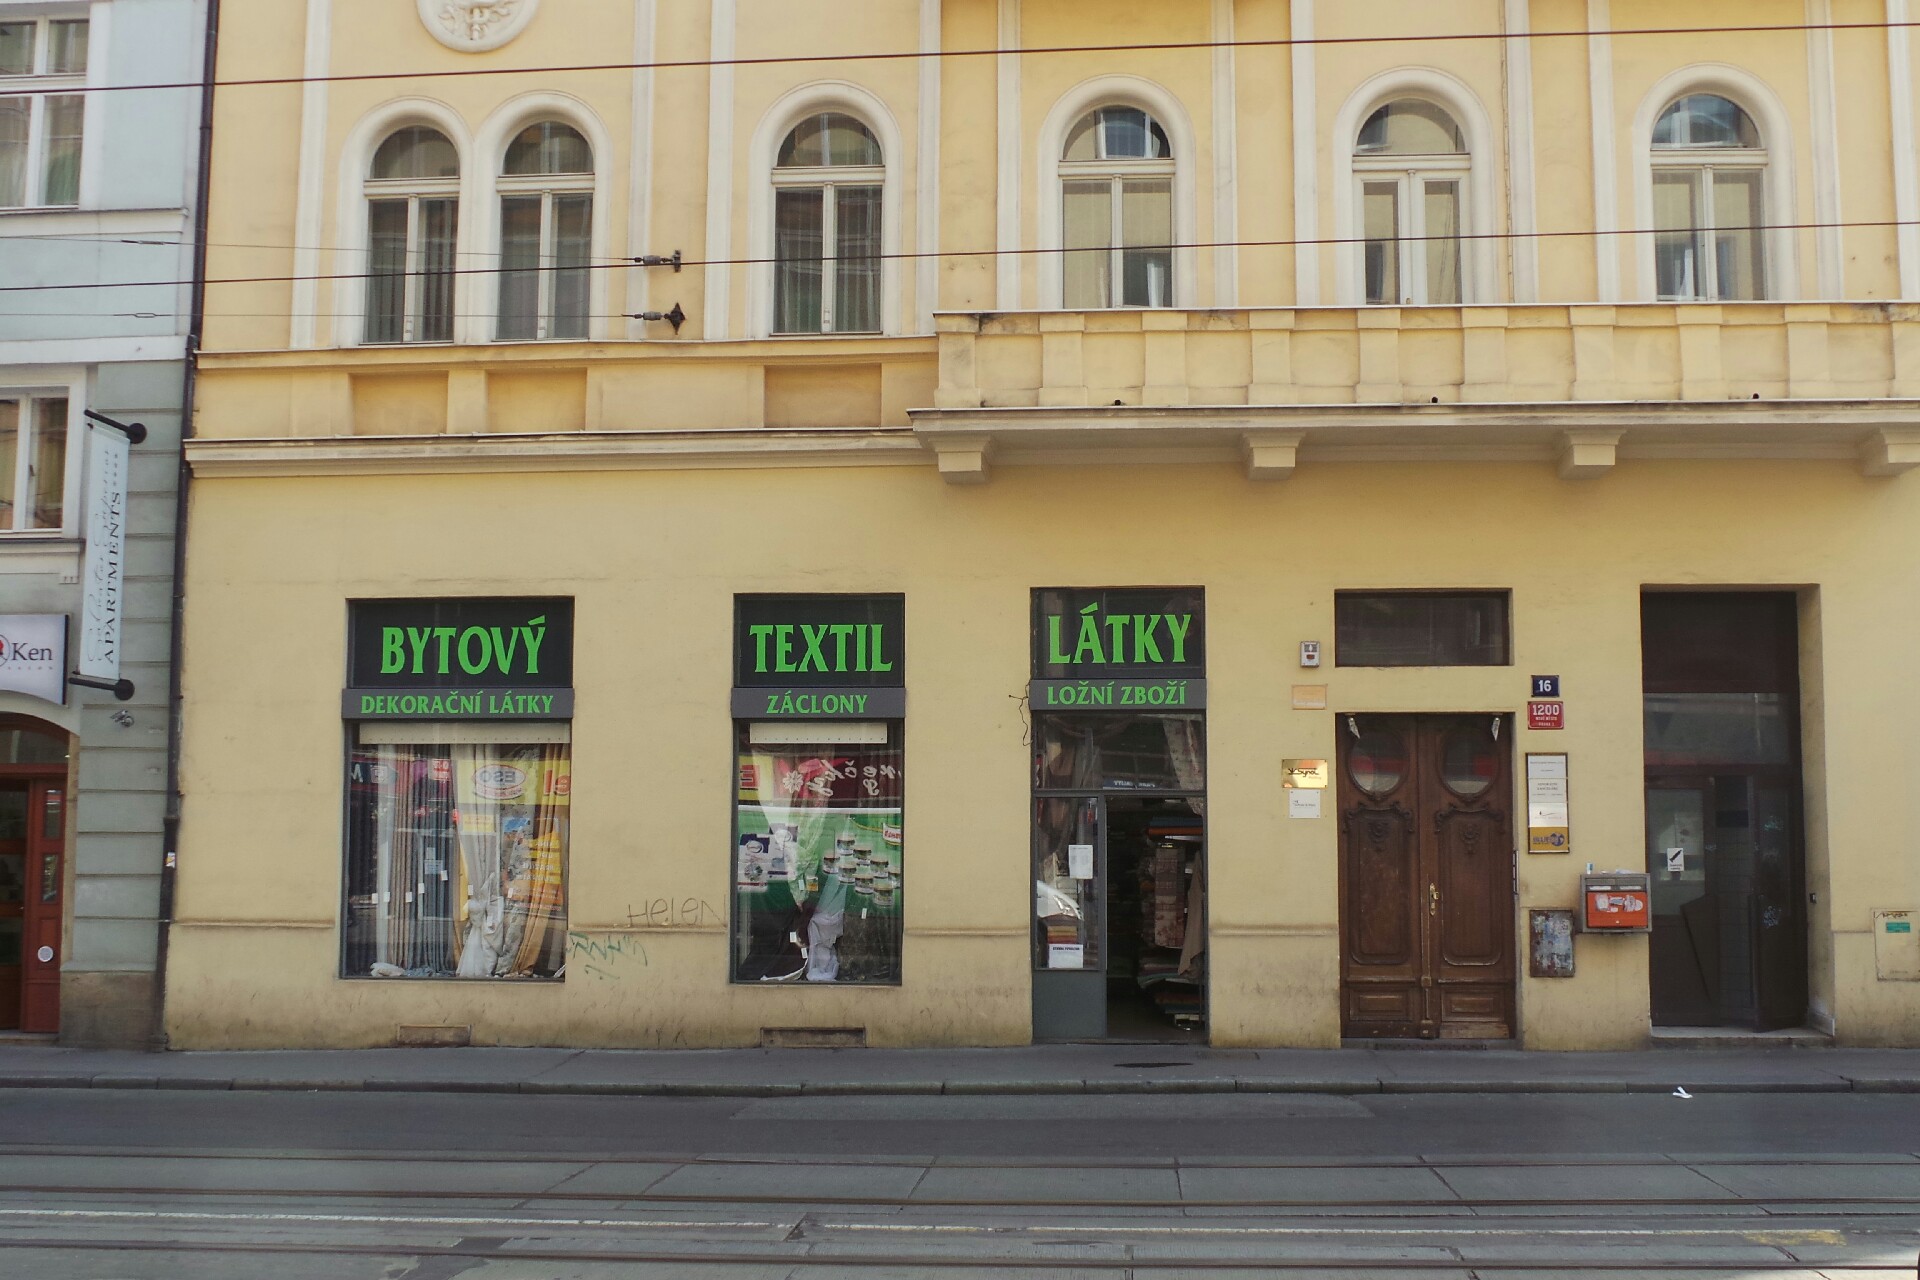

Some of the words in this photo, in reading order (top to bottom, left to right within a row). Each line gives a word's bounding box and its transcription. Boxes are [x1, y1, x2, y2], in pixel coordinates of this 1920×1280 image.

[104, 492, 121, 664] APARTMENTS
[380, 615, 547, 676] BYTOVÝ
[1048, 602, 1191, 665] LÁTKY
[11, 642, 53, 661] Ken
[748, 623, 893, 673] TEXTIL
[1047, 679, 1113, 705] LOŽNÍ
[1120, 681, 1186, 705] ZBOŽÍ
[1538, 679, 1552, 692] 16
[360, 690, 482, 715] DEKORAČNÍ
[488, 690, 554, 715] LÁTKY
[766, 691, 868, 714] ZÁCLONY
[1532, 704, 1560, 716] 1200
